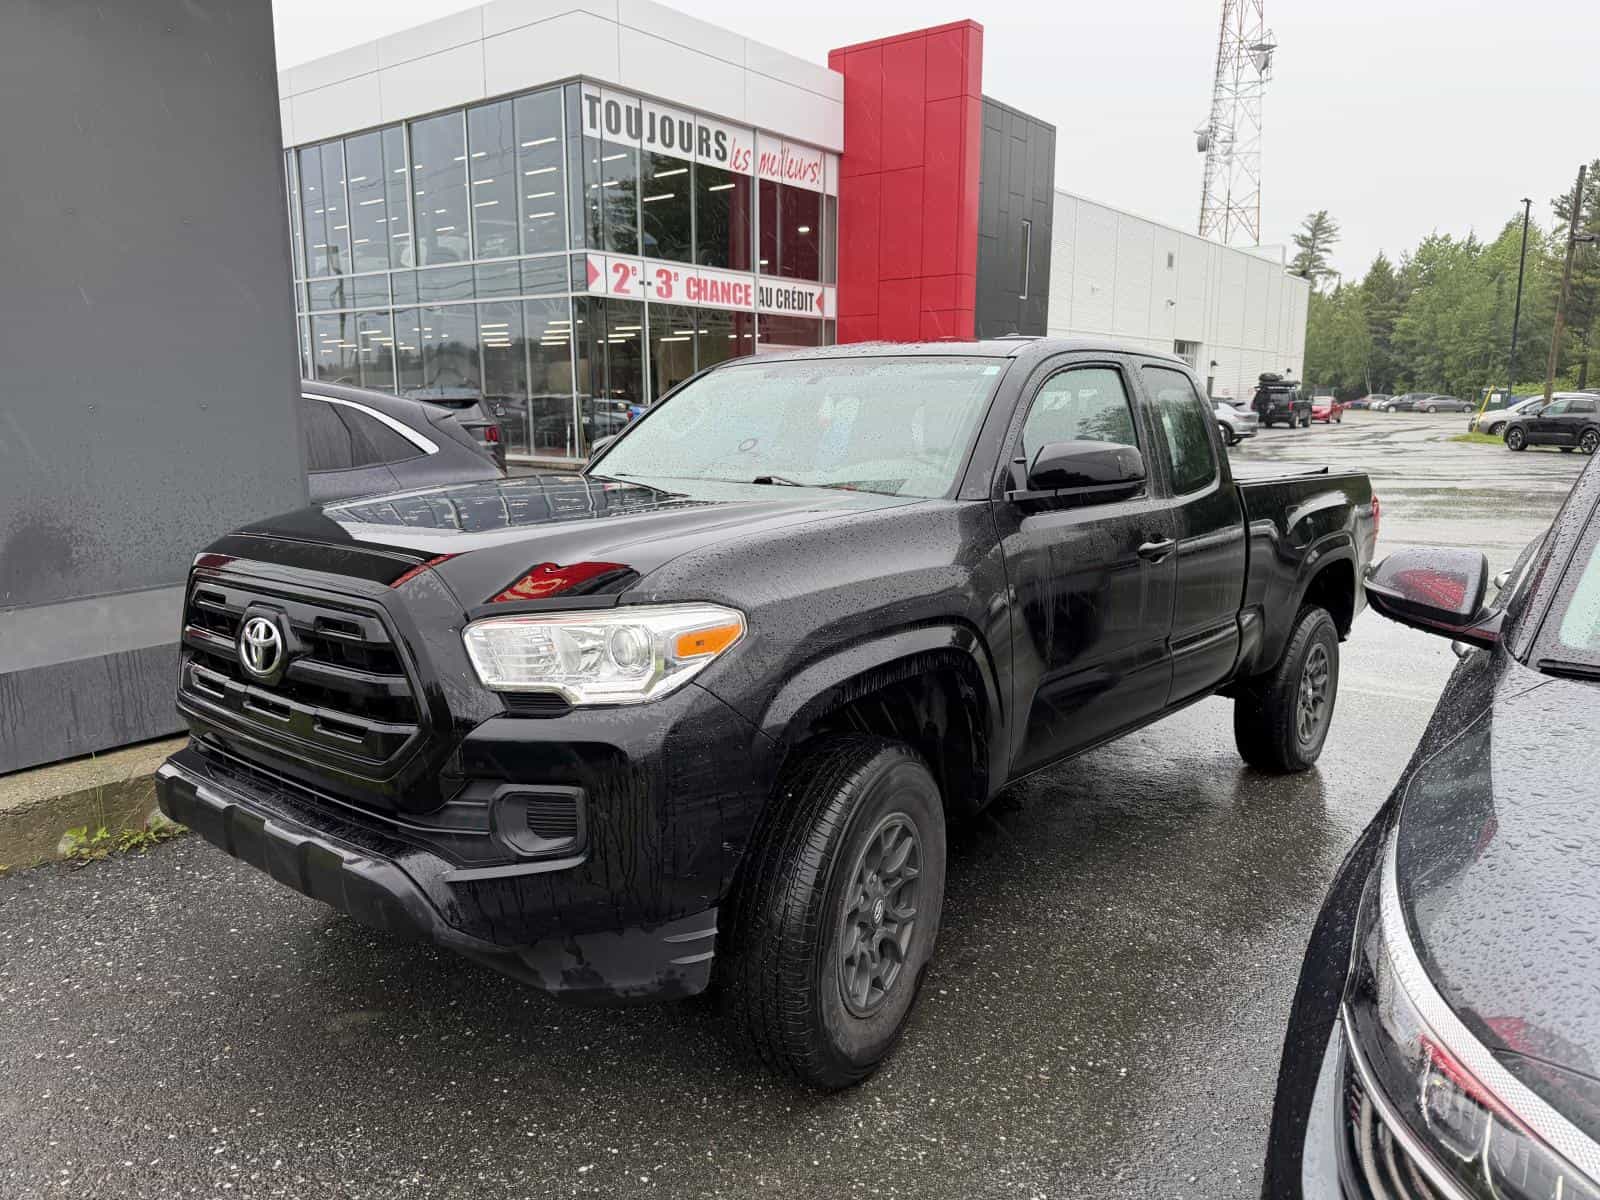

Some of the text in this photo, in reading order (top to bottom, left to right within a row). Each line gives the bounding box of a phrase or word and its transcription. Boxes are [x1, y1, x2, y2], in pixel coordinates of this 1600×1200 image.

[585, 94, 823, 184] TOUJOURS les meilleurs!
[686, 277, 752, 306] CHANCE
[759, 286, 773, 308] AU
[776, 287, 814, 312] CRÉDIT
